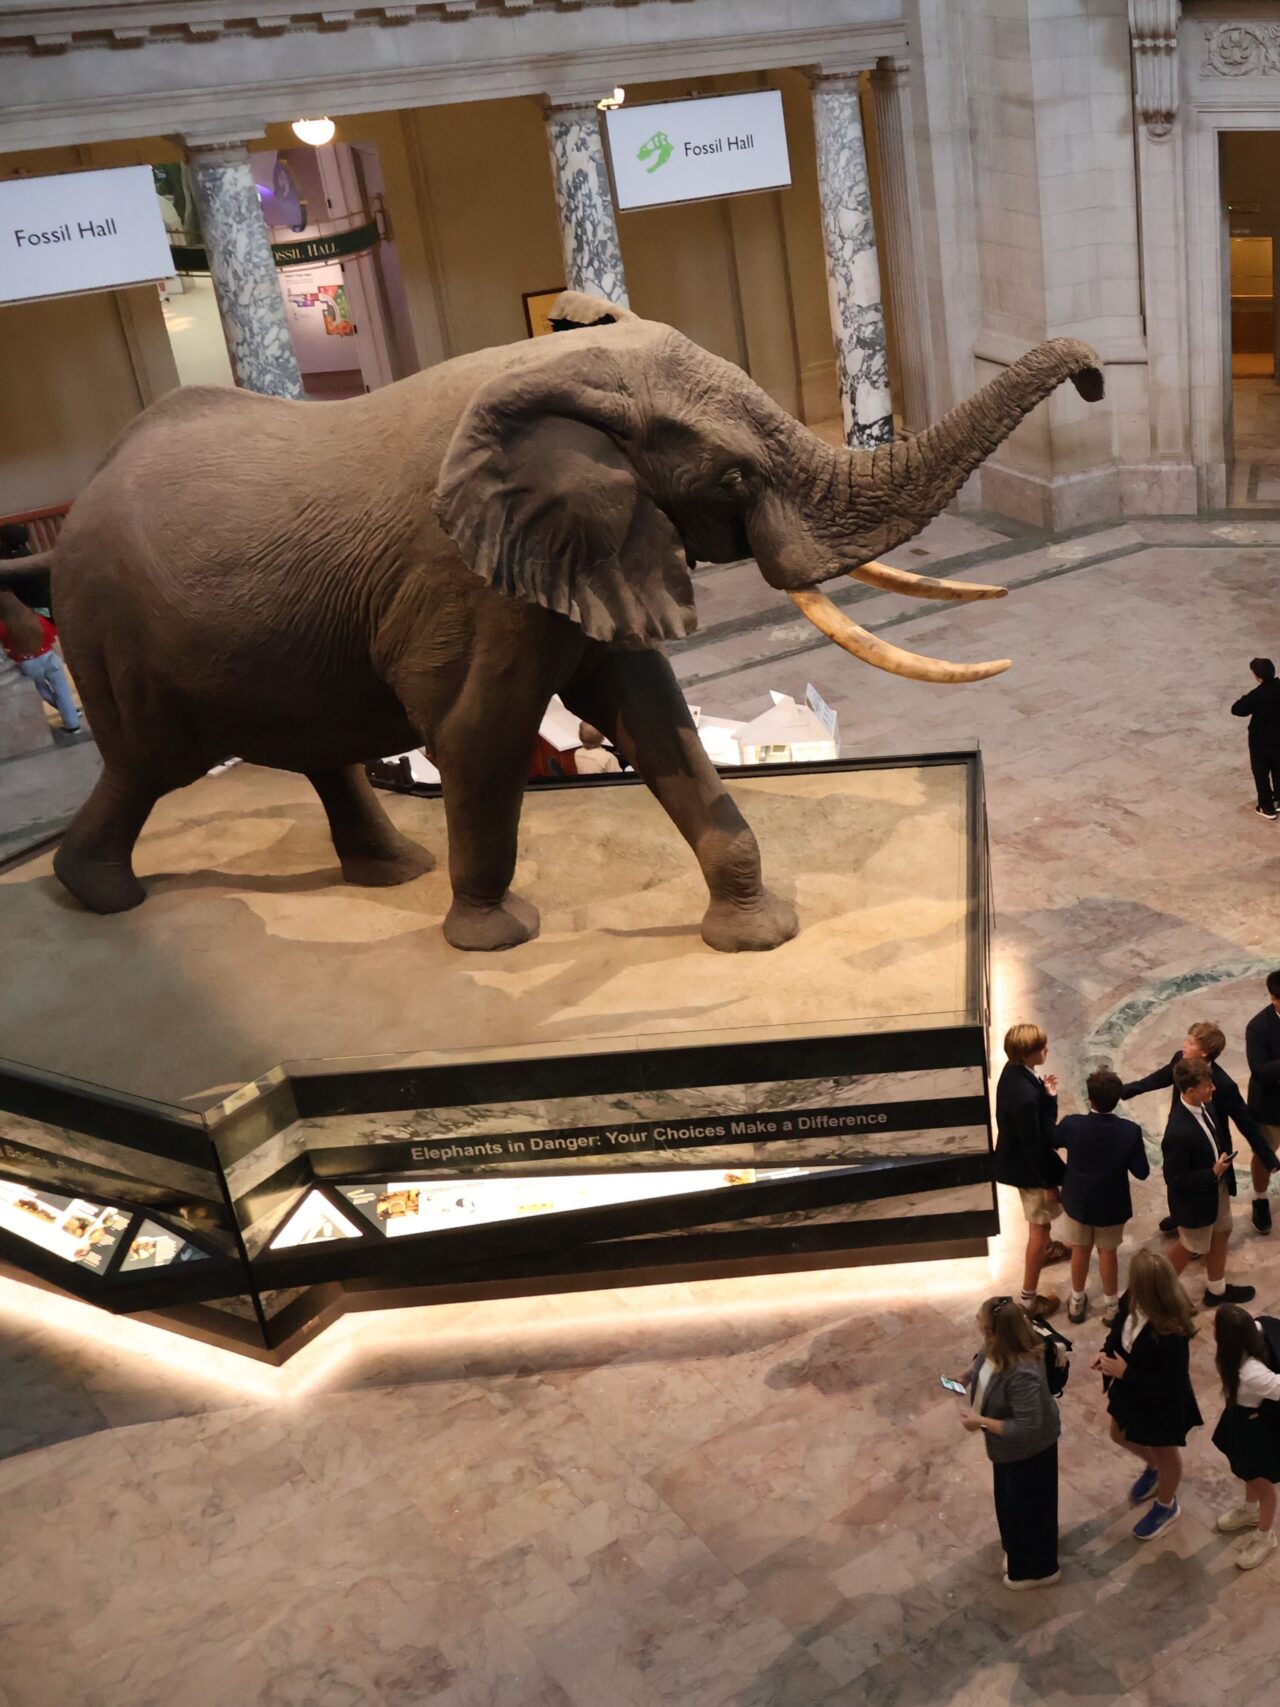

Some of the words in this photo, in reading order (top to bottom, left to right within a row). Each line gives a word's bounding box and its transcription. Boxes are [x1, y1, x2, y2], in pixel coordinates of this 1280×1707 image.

[684, 137, 722, 157] Fossil
[727, 133, 754, 151] Hall
[14, 224, 72, 247] Fossil
[77, 217, 118, 239] Hall
[411, 1142, 503, 1162] Elephants
[508, 1140, 525, 1153] in
[530, 1134, 601, 1151] Danger:
[606, 1130, 648, 1144] Your
[653, 1125, 726, 1141] Choices
[730, 1119, 777, 1135] Make
[782, 1121, 793, 1131] a
[798, 1114, 888, 1130] Difference
